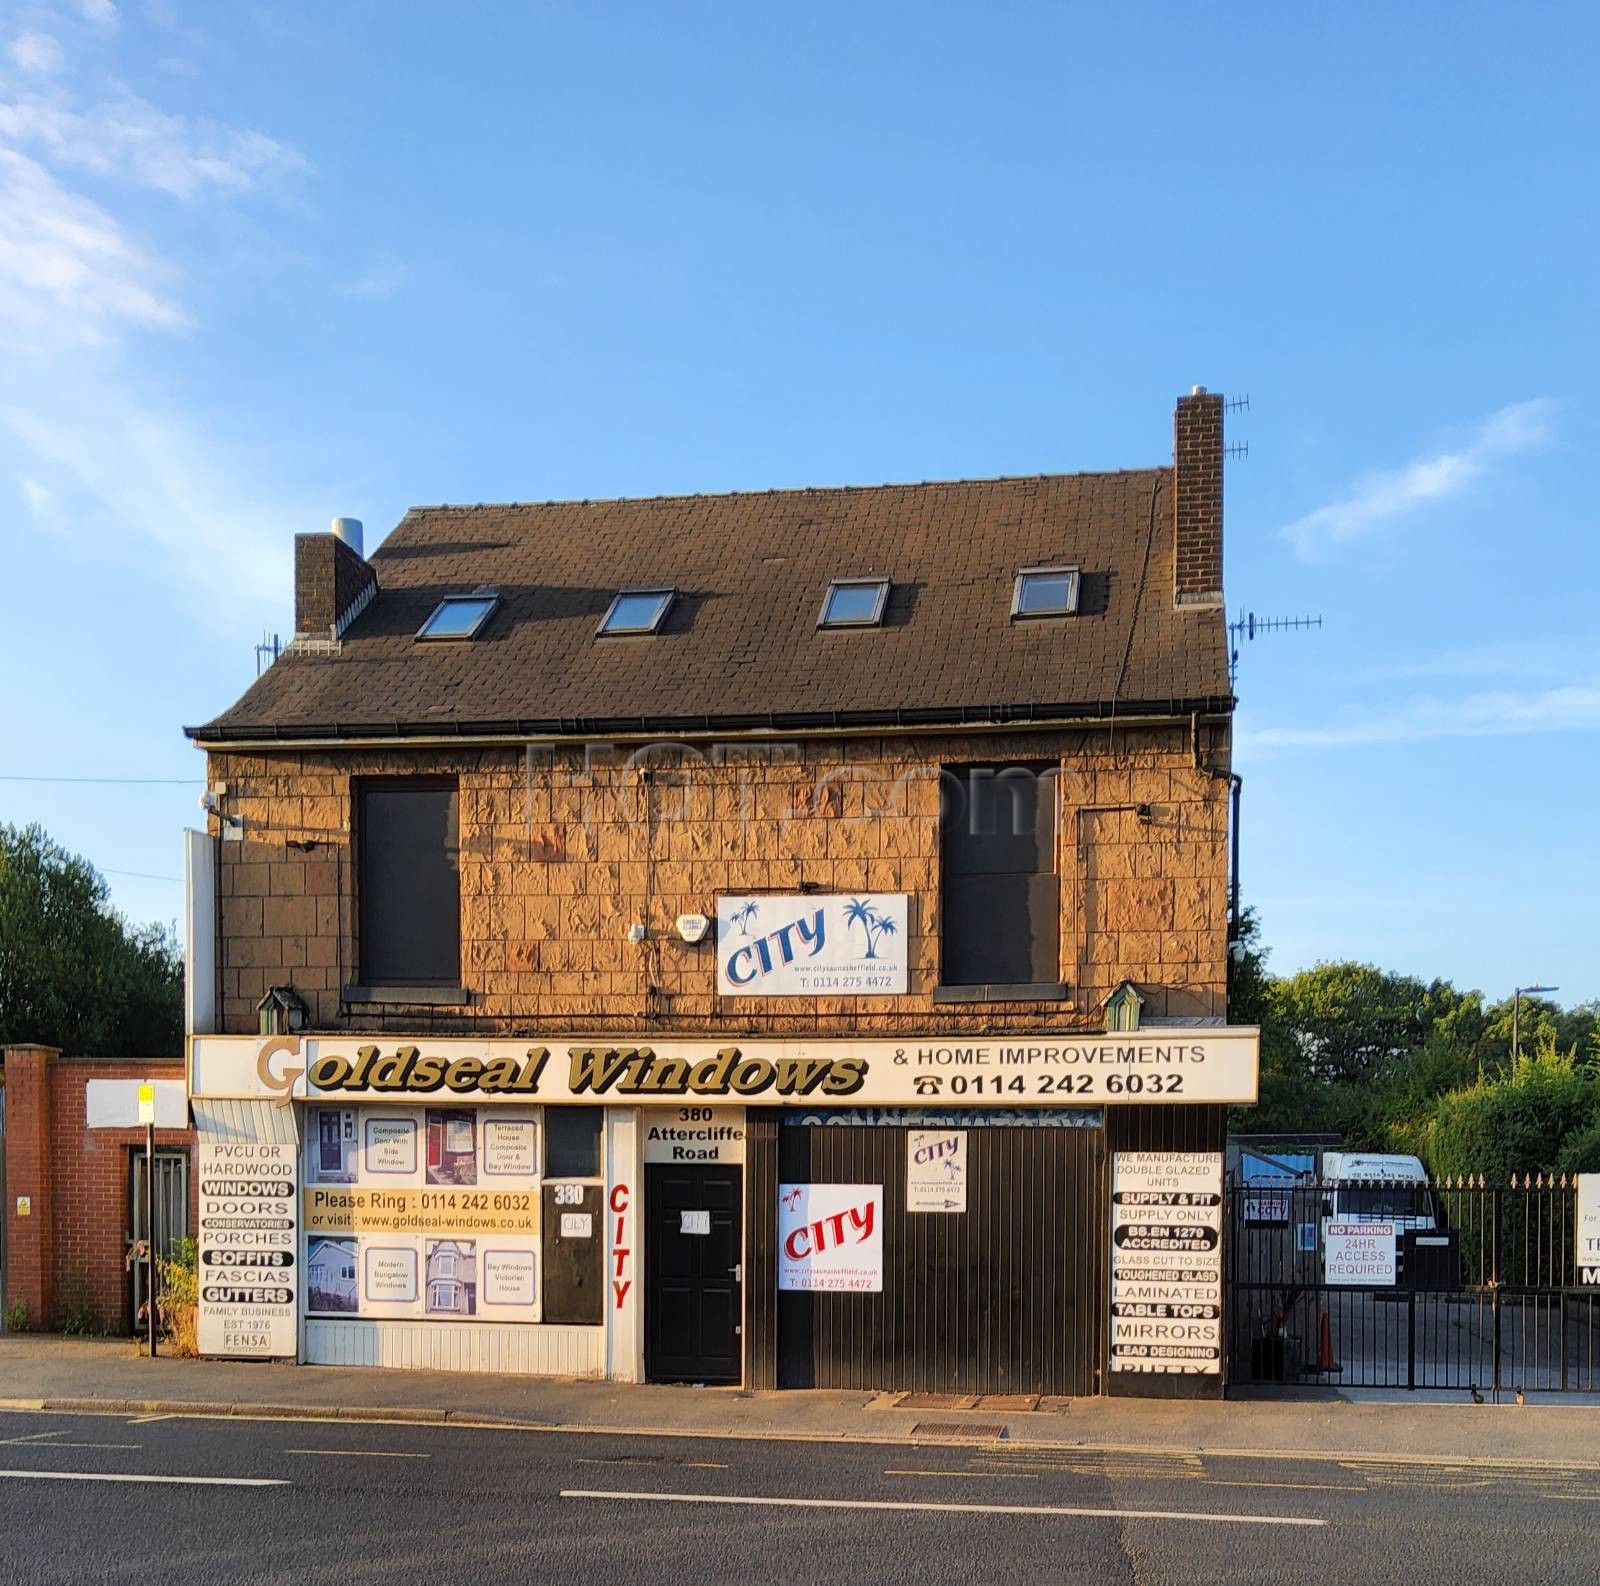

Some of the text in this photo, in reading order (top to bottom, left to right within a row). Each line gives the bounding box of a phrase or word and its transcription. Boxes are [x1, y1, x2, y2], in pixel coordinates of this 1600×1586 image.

[725, 907, 826, 988] CITY
[814, 977, 838, 987] 0114
[842, 977, 861, 987] 275
[865, 976, 892, 987] 4472
[893, 1046, 1205, 1064] & HOME IMPROVEMENTS
[257, 1038, 870, 1108] Goldseal Windows
[950, 1074, 1184, 1094] 0114 242 6032
[679, 1107, 713, 1122] 380
[648, 1127, 744, 1140] Attercliffe
[214, 1146, 280, 1158] PVCU OR
[673, 1146, 719, 1159] Road
[914, 1136, 959, 1165] CITY
[1117, 1153, 1221, 1163] WE MANUFACTURE
[203, 1163, 292, 1175] HARDWOOD
[1117, 1165, 1210, 1175] DOUBLE GLAZED
[1147, 1178, 1179, 1186] UNITS
[205, 1182, 289, 1196] WINDOWS
[554, 1184, 584, 1205] 380
[315, 1191, 365, 1208] Please
[371, 1193, 406, 1213] Ring
[421, 1194, 457, 1209] 0114
[462, 1194, 488, 1210] 242
[494, 1195, 530, 1210] 6032
[1122, 1193, 1213, 1205] SUPPLY & FIT
[206, 1202, 288, 1214] DOORS
[1120, 1209, 1213, 1220] SUPPLY ONLY
[205, 1219, 289, 1228] CONSERVATORIES
[312, 1215, 323, 1225] or
[327, 1213, 351, 1225] visit
[361, 1214, 533, 1230] www.goldseal-windows.co.uk
[784, 1201, 874, 1262] CITY
[1173, 1228, 1204, 1238] 1279
[1330, 1226, 1391, 1235] NO PARKING
[203, 1232, 292, 1244] PORCHES
[1121, 1238, 1210, 1250] ACCREDITED
[1345, 1239, 1376, 1249] 24HR
[610, 1184, 631, 1309] CITY
[211, 1251, 283, 1265] SOFFITS
[1114, 1256, 1220, 1265] GLASS CUT TO SIZE
[1336, 1251, 1385, 1261] ACCESS
[1329, 1264, 1392, 1274] REQUIRED
[205, 1270, 290, 1282] FASCIAS
[1117, 1270, 1216, 1281] TOUGHENED GLASS
[802, 1278, 824, 1287] 0114
[828, 1279, 845, 1288] 275
[848, 1279, 872, 1288] 4472
[206, 1288, 288, 1302] GUTTERS
[1114, 1287, 1218, 1299] LAMINATED
[203, 1307, 291, 1316] FAMILY BUSINESS
[1116, 1304, 1213, 1318] TABLE TOPS
[224, 1320, 270, 1329] EST 1976
[1117, 1325, 1215, 1339] MIRRORS
[225, 1334, 267, 1346] FENSA
[1116, 1346, 1214, 1358] LEAD DESIGNING
